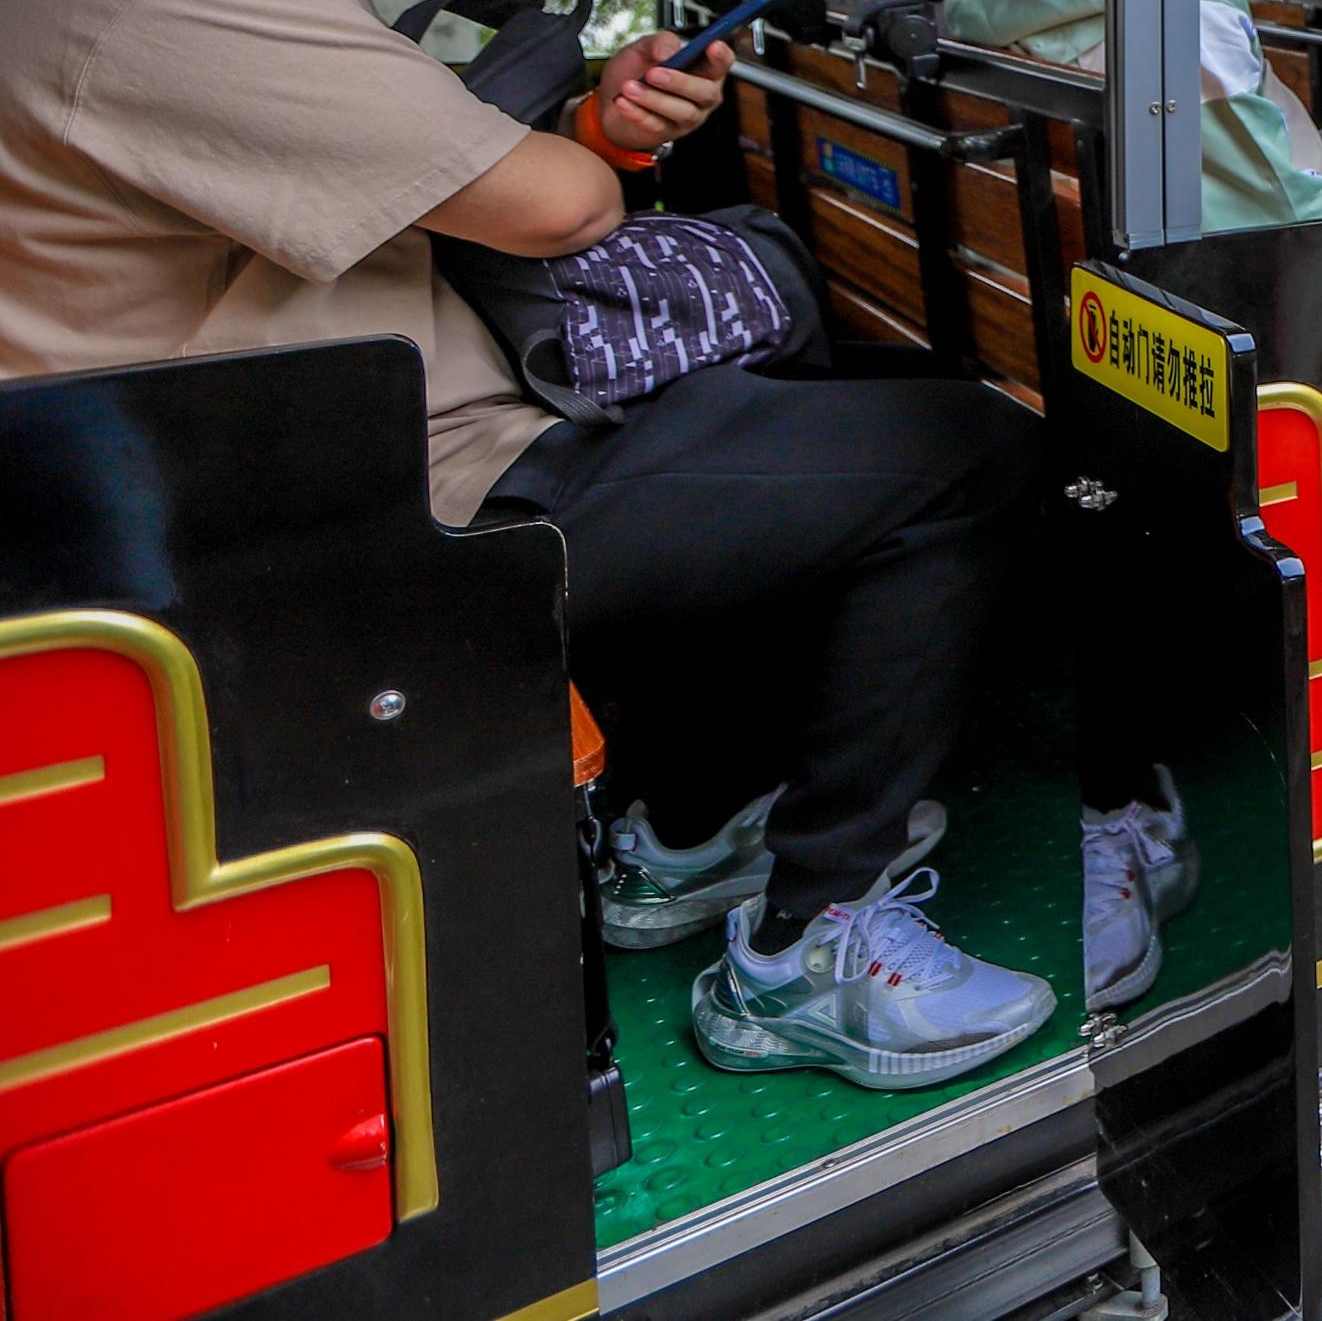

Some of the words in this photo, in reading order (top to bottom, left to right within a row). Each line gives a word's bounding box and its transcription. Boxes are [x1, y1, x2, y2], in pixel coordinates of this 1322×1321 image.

[1109, 310, 1216, 419] 自动门请勿推拉
